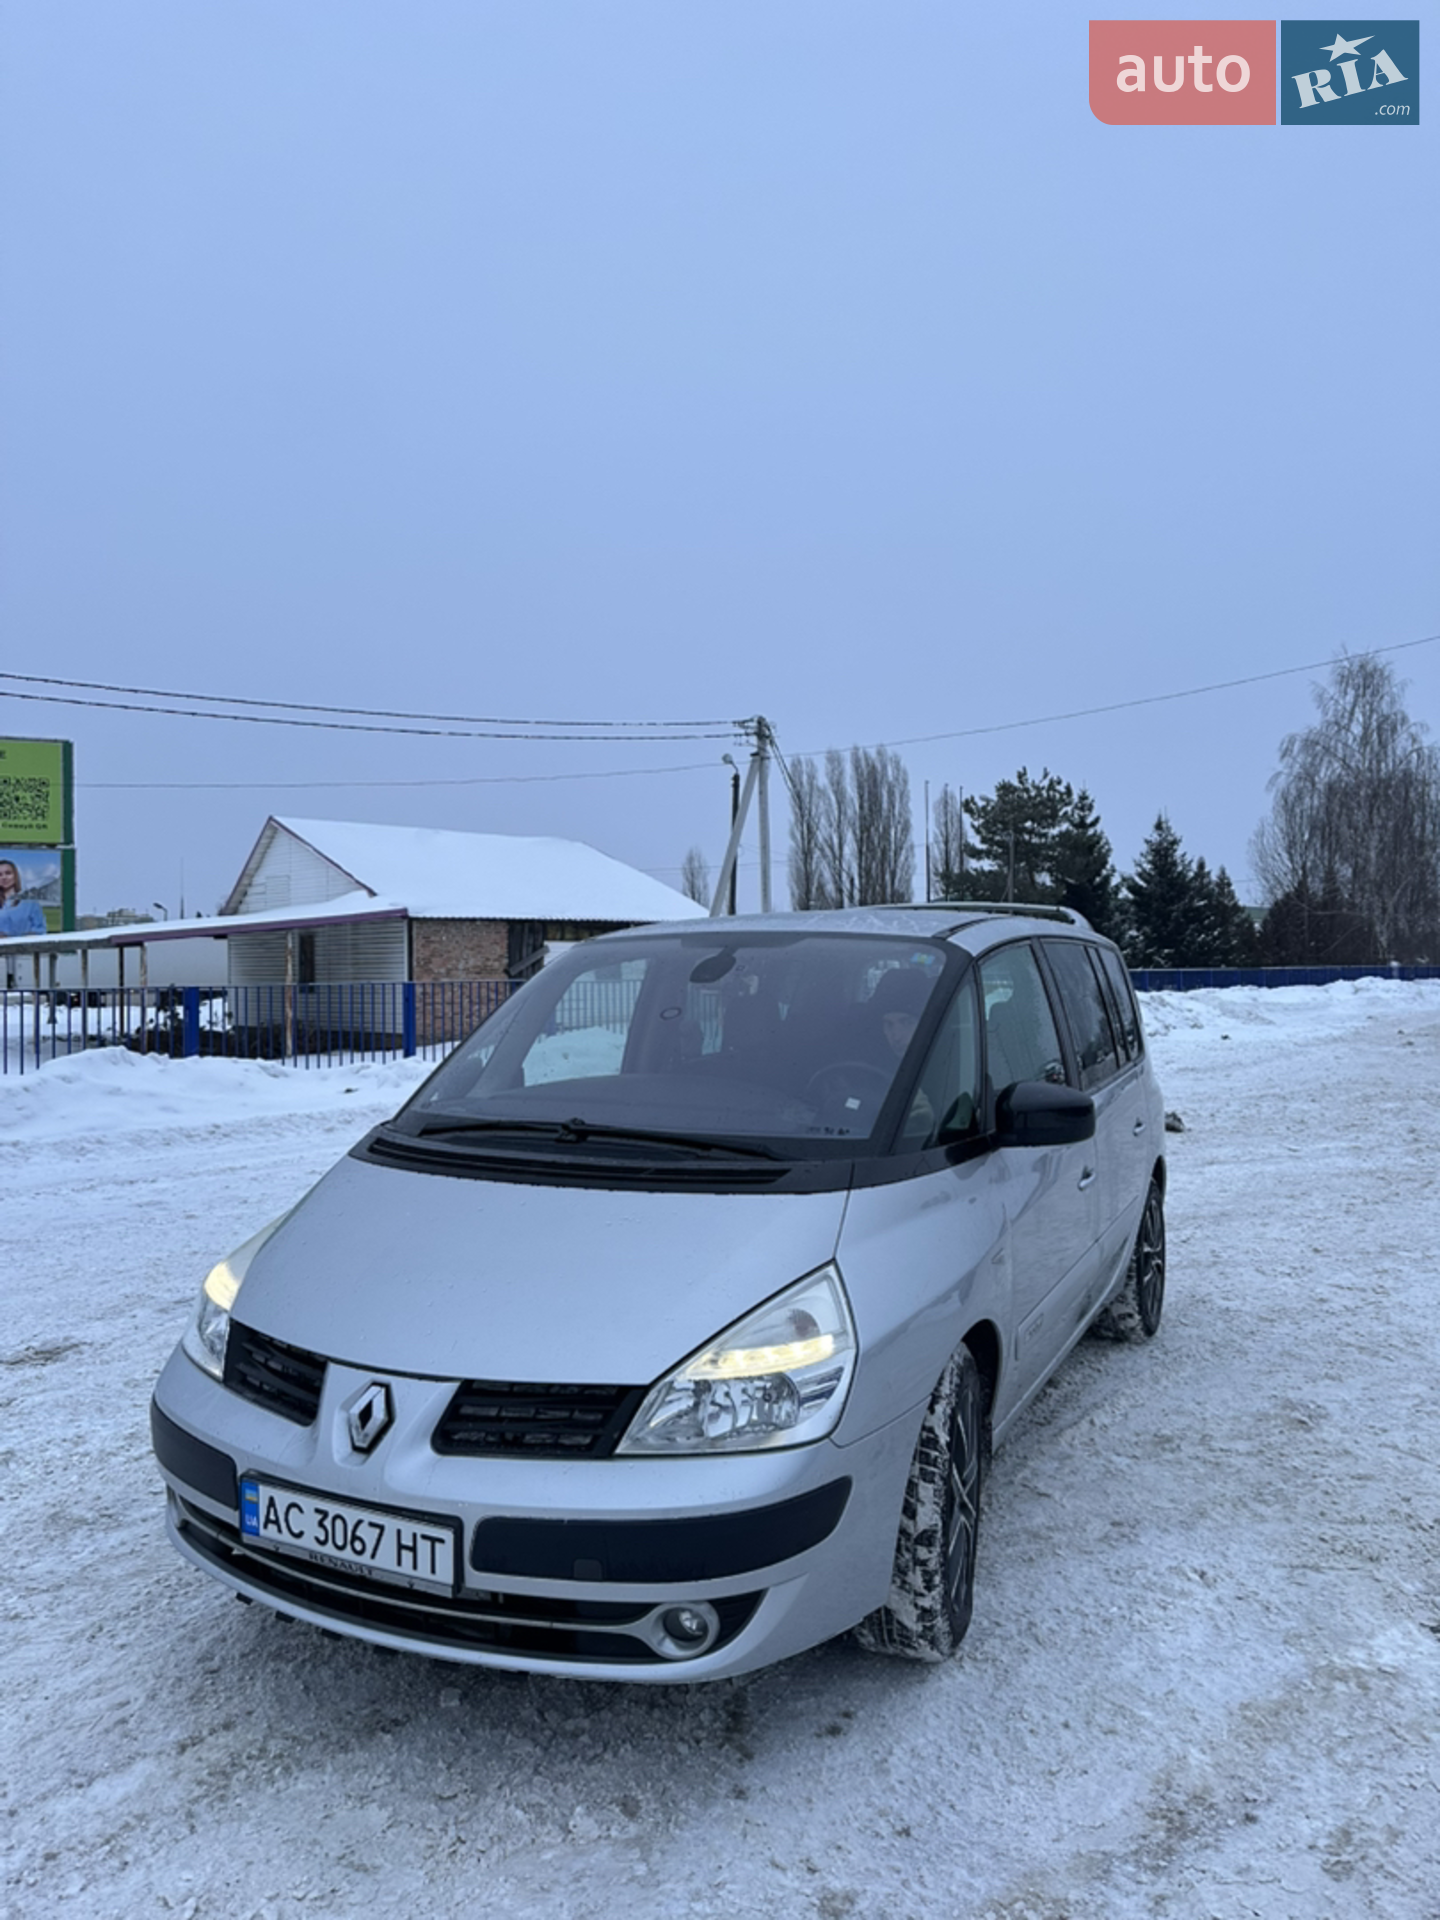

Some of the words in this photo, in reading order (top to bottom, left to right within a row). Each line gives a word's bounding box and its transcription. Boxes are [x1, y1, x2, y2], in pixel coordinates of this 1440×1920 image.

[245, 1514, 259, 1528] UA
[263, 1495, 305, 1539] AC
[314, 1507, 385, 1560] 3067
[396, 1528, 446, 1576] HT
